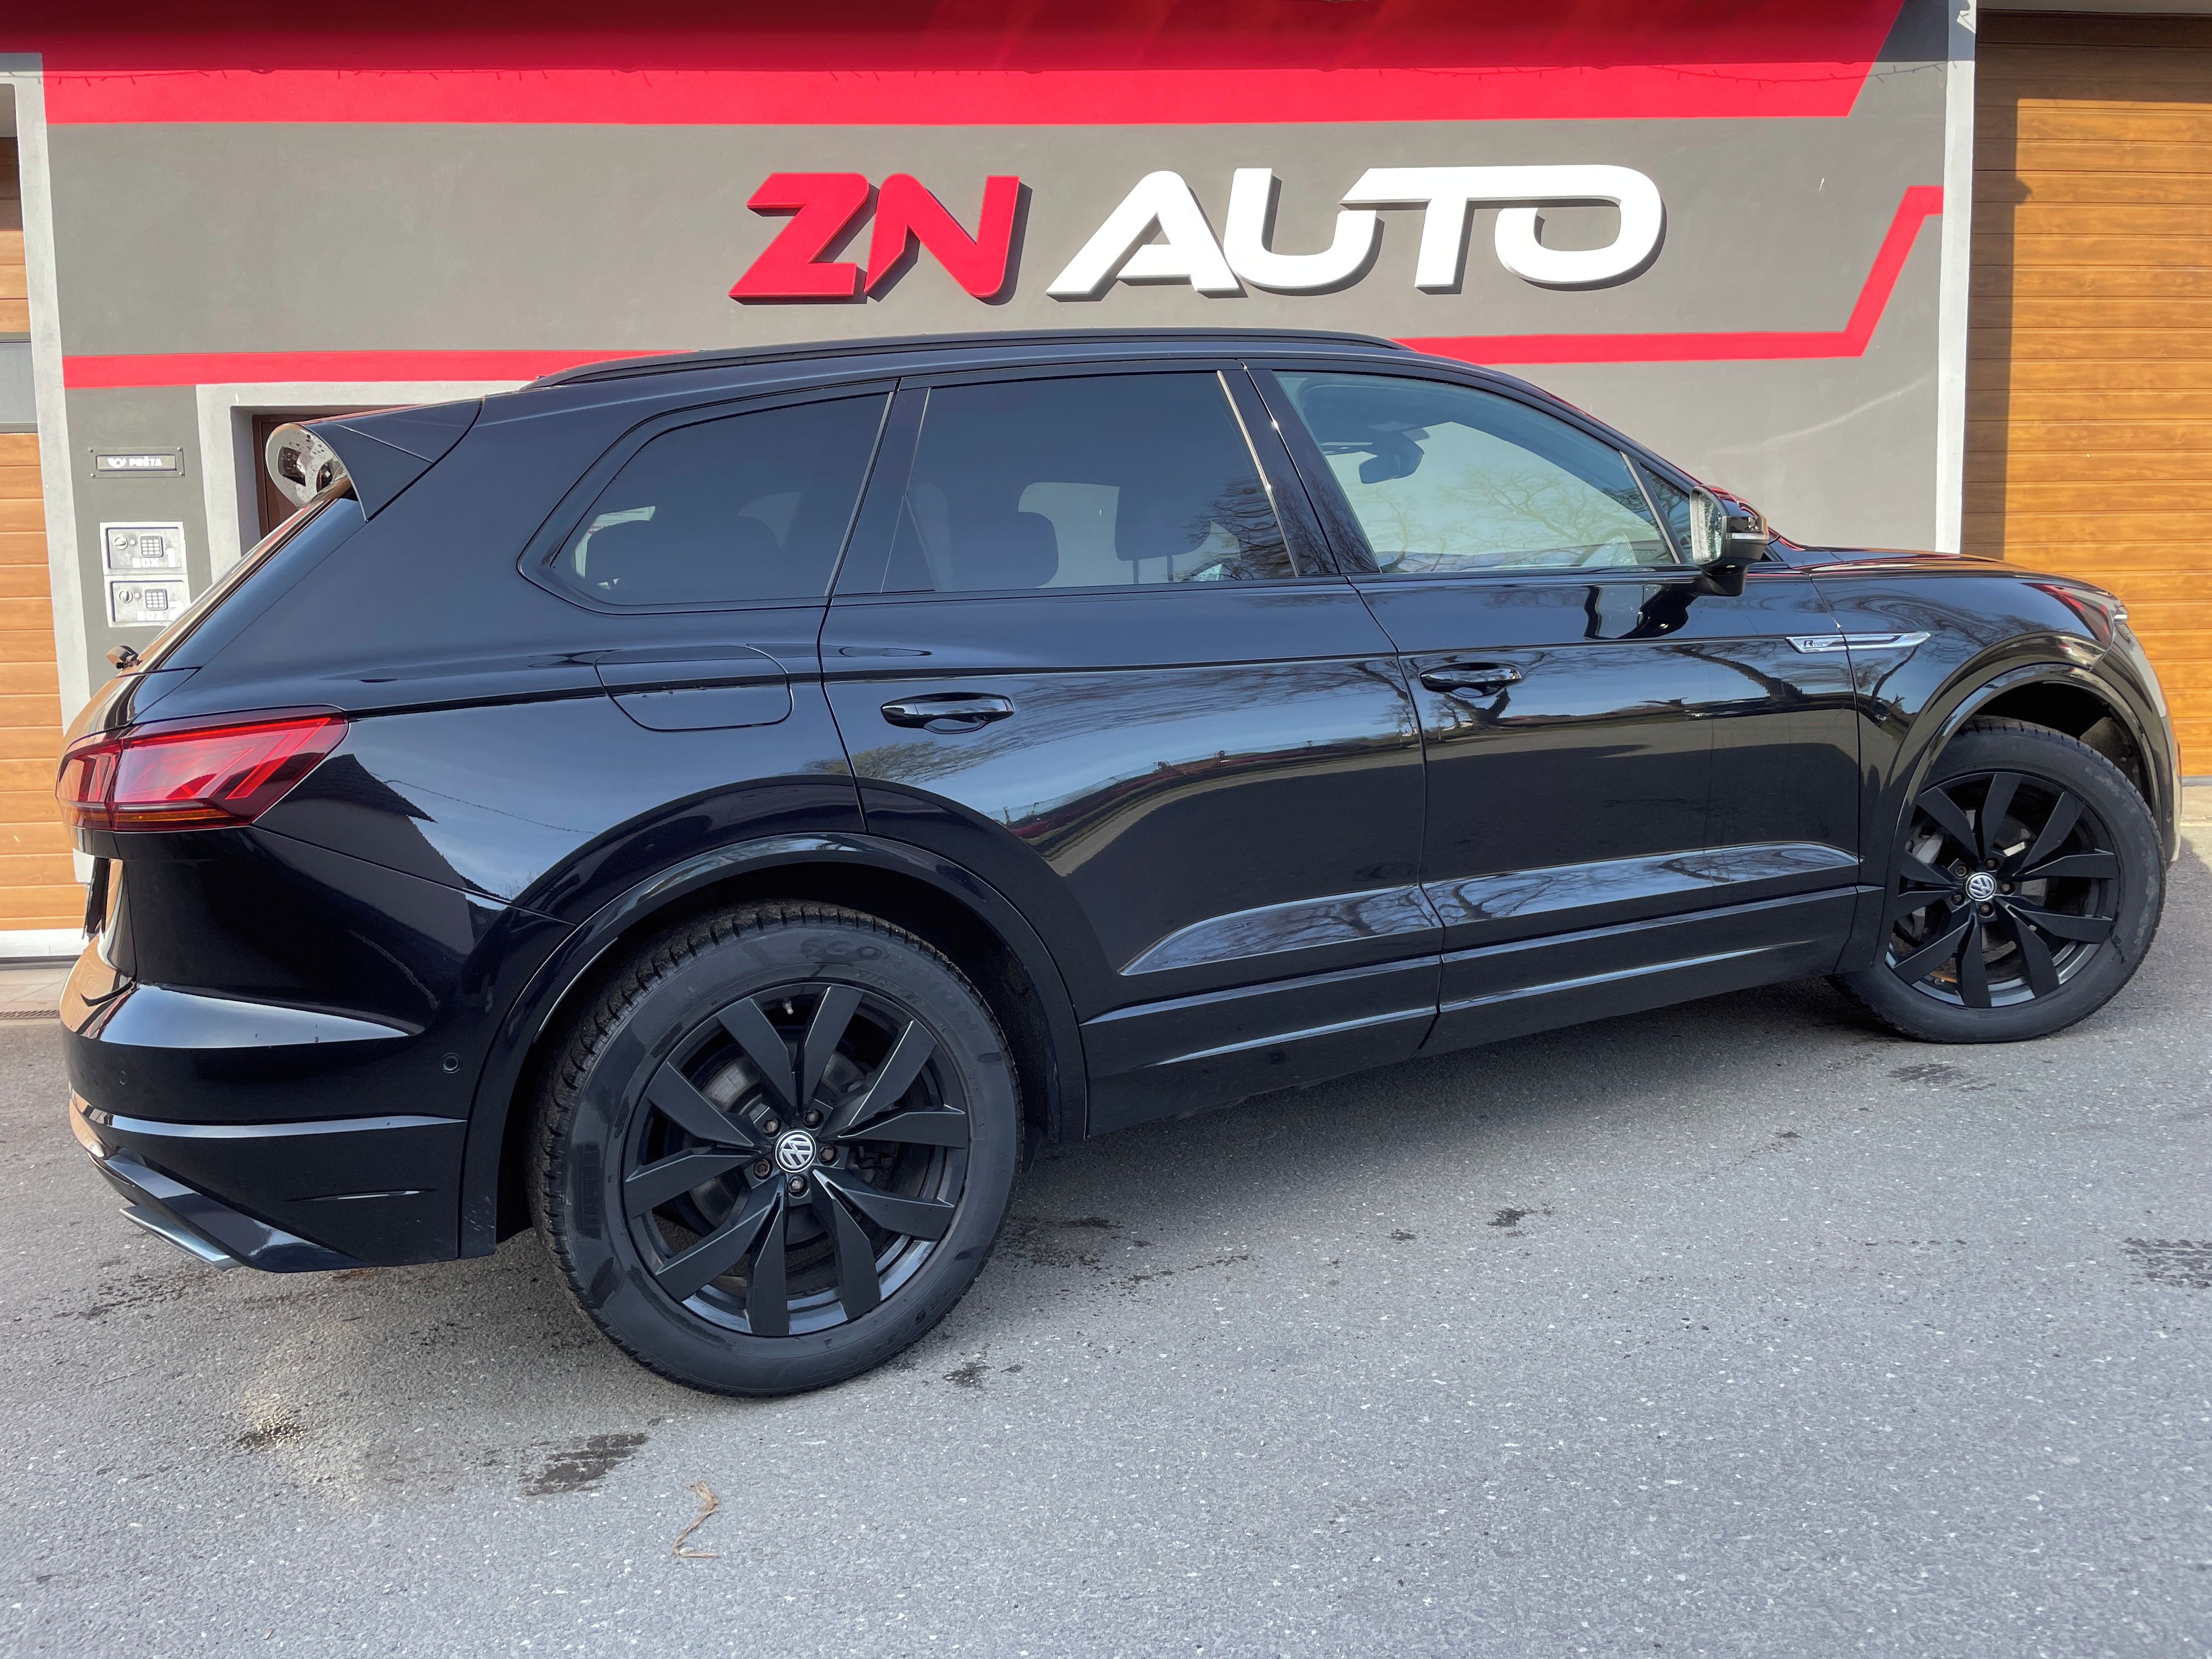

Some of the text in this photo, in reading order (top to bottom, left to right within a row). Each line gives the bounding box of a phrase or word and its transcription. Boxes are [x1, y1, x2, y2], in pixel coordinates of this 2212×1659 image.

[729, 165, 1663, 300] ZN AUTO
[132, 548, 177, 568] BOX 1
[137, 601, 185, 622] BOX 2
